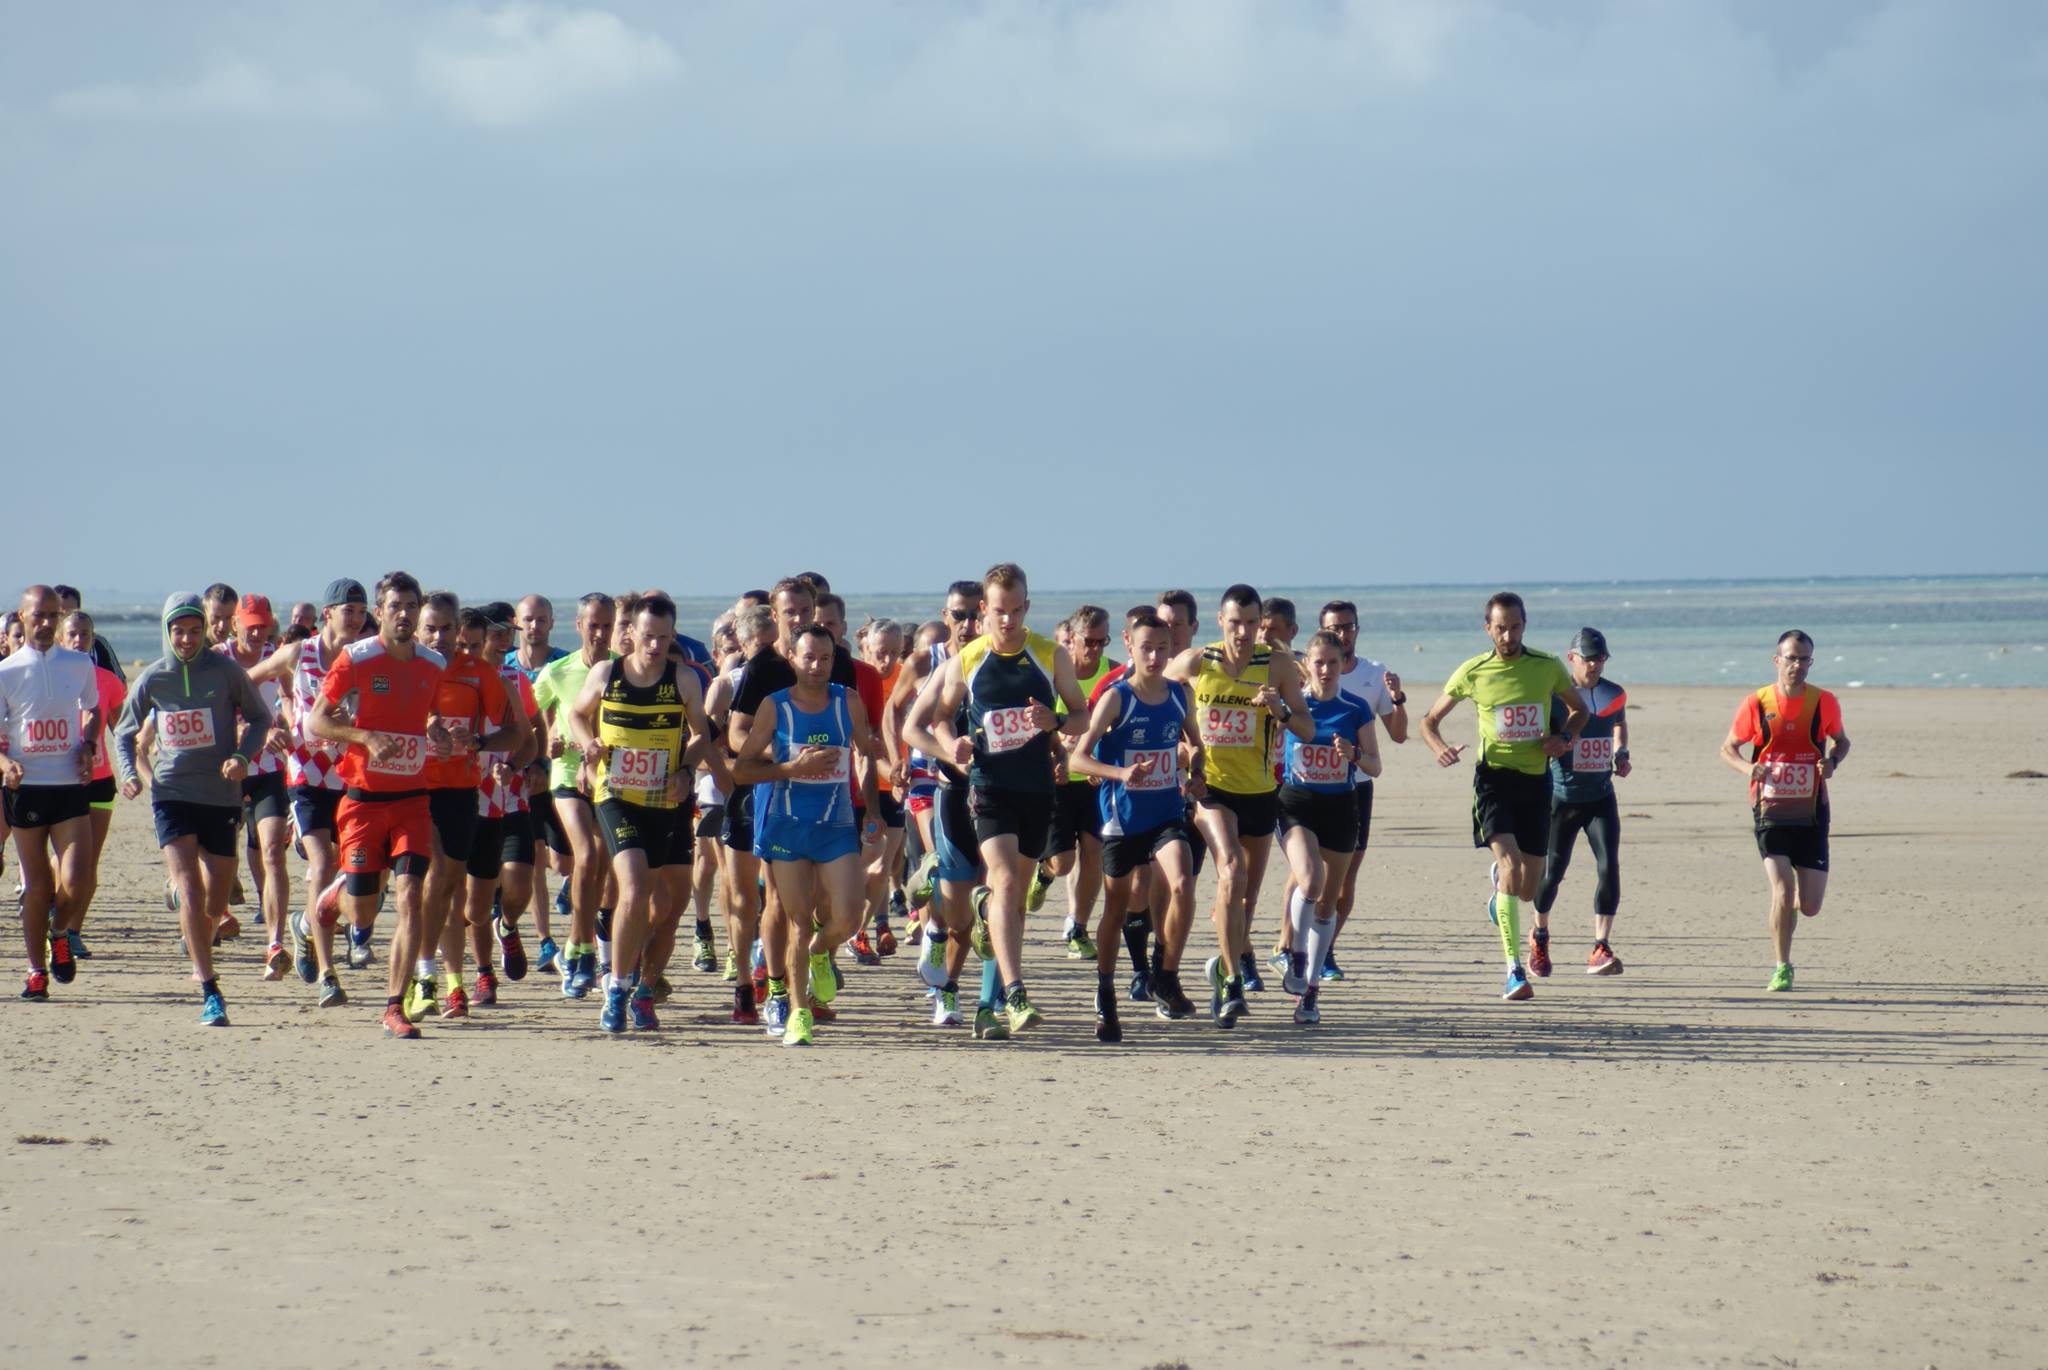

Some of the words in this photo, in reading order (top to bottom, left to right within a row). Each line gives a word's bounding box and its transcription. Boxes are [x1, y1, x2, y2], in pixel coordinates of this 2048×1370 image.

[1208, 708, 1248, 733] 943
[1504, 705, 1538, 727] 952
[166, 710, 204, 735] 856
[27, 719, 68, 741] 1000
[1498, 729, 1531, 738] adidas
[164, 738, 198, 746] adidas
[991, 737, 1025, 748] adidas
[1203, 734, 1237, 744] adidas
[22, 744, 58, 753] adidas
[1581, 739, 1610, 758] 999
[621, 751, 657, 775] 951
[1302, 745, 1341, 769] 960
[371, 760, 406, 771] adidas
[1575, 761, 1603, 769] adidas
[611, 775, 649, 787] adidas
